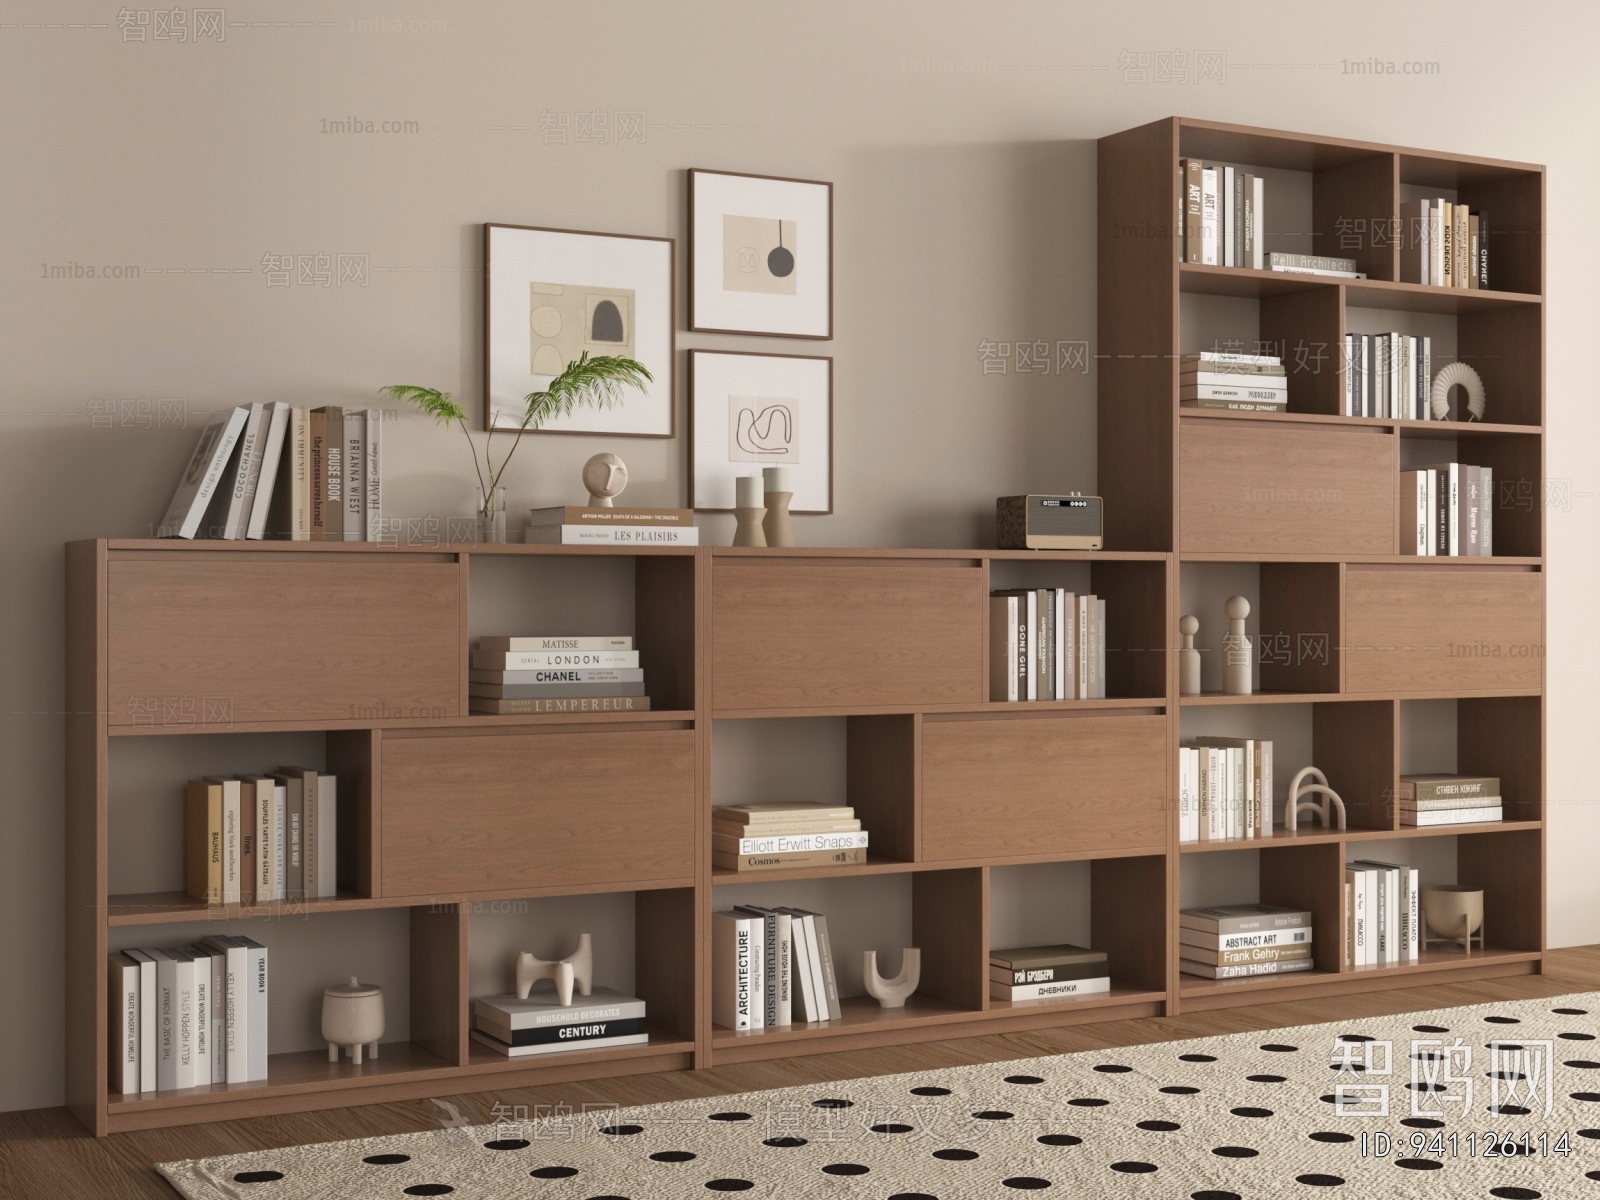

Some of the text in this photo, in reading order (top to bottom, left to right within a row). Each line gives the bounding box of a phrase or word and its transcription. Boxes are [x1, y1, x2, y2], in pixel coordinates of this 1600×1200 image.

[1189, 184, 1200, 202] ART
[1205, 193, 1214, 210] ART
[1273, 254, 1353, 271] Pelli Architects
[1248, 391, 1276, 399] РОКФЕЛЛЕР
[298, 425, 304, 436] ON
[328, 448, 340, 501] HOUSE BOOK
[350, 440, 359, 514] BRIANNA WIEST
[369, 478, 379, 509] HOME
[314, 501, 323, 527] herself
[614, 531, 678, 541] LES PLAISIRS
[542, 640, 578, 648] MATISSE
[547, 656, 600, 665] LONDON
[536, 672, 581, 682] CHANEL
[535, 699, 633, 712] LEMPEREUR
[1436, 784, 1482, 794] СТИВЕН ХОКИНГ
[244, 836, 252, 856] lines.
[743, 836, 853, 854] Elliott Erwitt Snaps
[748, 857, 780, 866] Cosmos
[1226, 934, 1277, 948] ABSTRACT ART
[1224, 948, 1280, 962] Frank Gehry
[738, 930, 748, 1015] ARCHITECTURE
[768, 915, 776, 1026] FURNITURE DESIGN
[1015, 969, 1053, 983] РЭЙ БРЭДБЕРИ
[1222, 963, 1277, 977] Zaha Hadid
[1039, 985, 1076, 995] ДНЕВНИКИ
[182, 991, 190, 1011] STYLE
[164, 1017, 170, 1025] OF
[536, 1008, 620, 1024] HOUSEHOLD DECORATES
[559, 1024, 606, 1038] CENTURY
